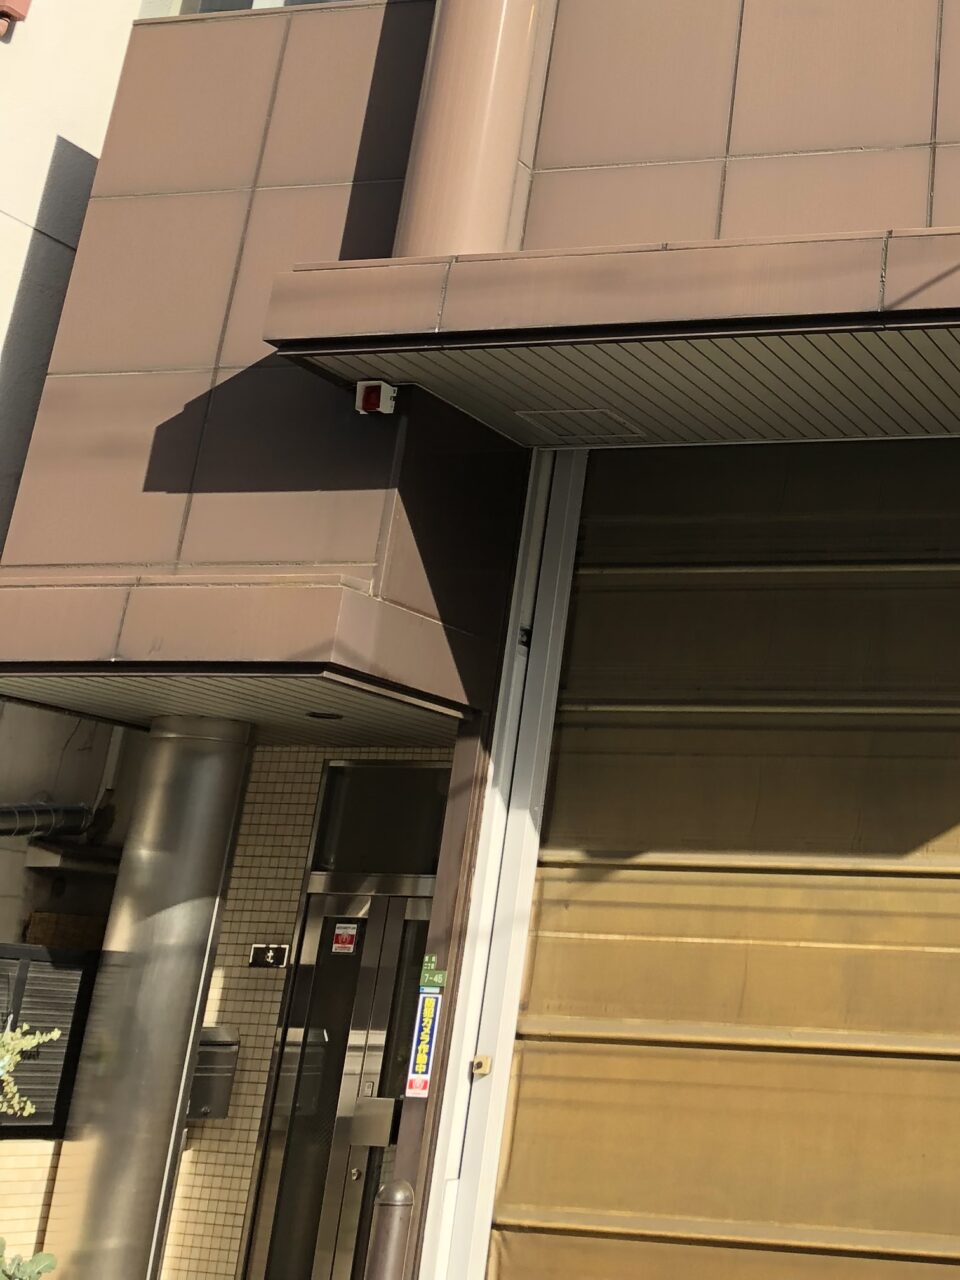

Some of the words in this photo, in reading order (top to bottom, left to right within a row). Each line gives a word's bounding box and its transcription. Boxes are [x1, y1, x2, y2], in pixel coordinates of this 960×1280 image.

[415, 997, 435, 1074] 防犯カメラ作動中
